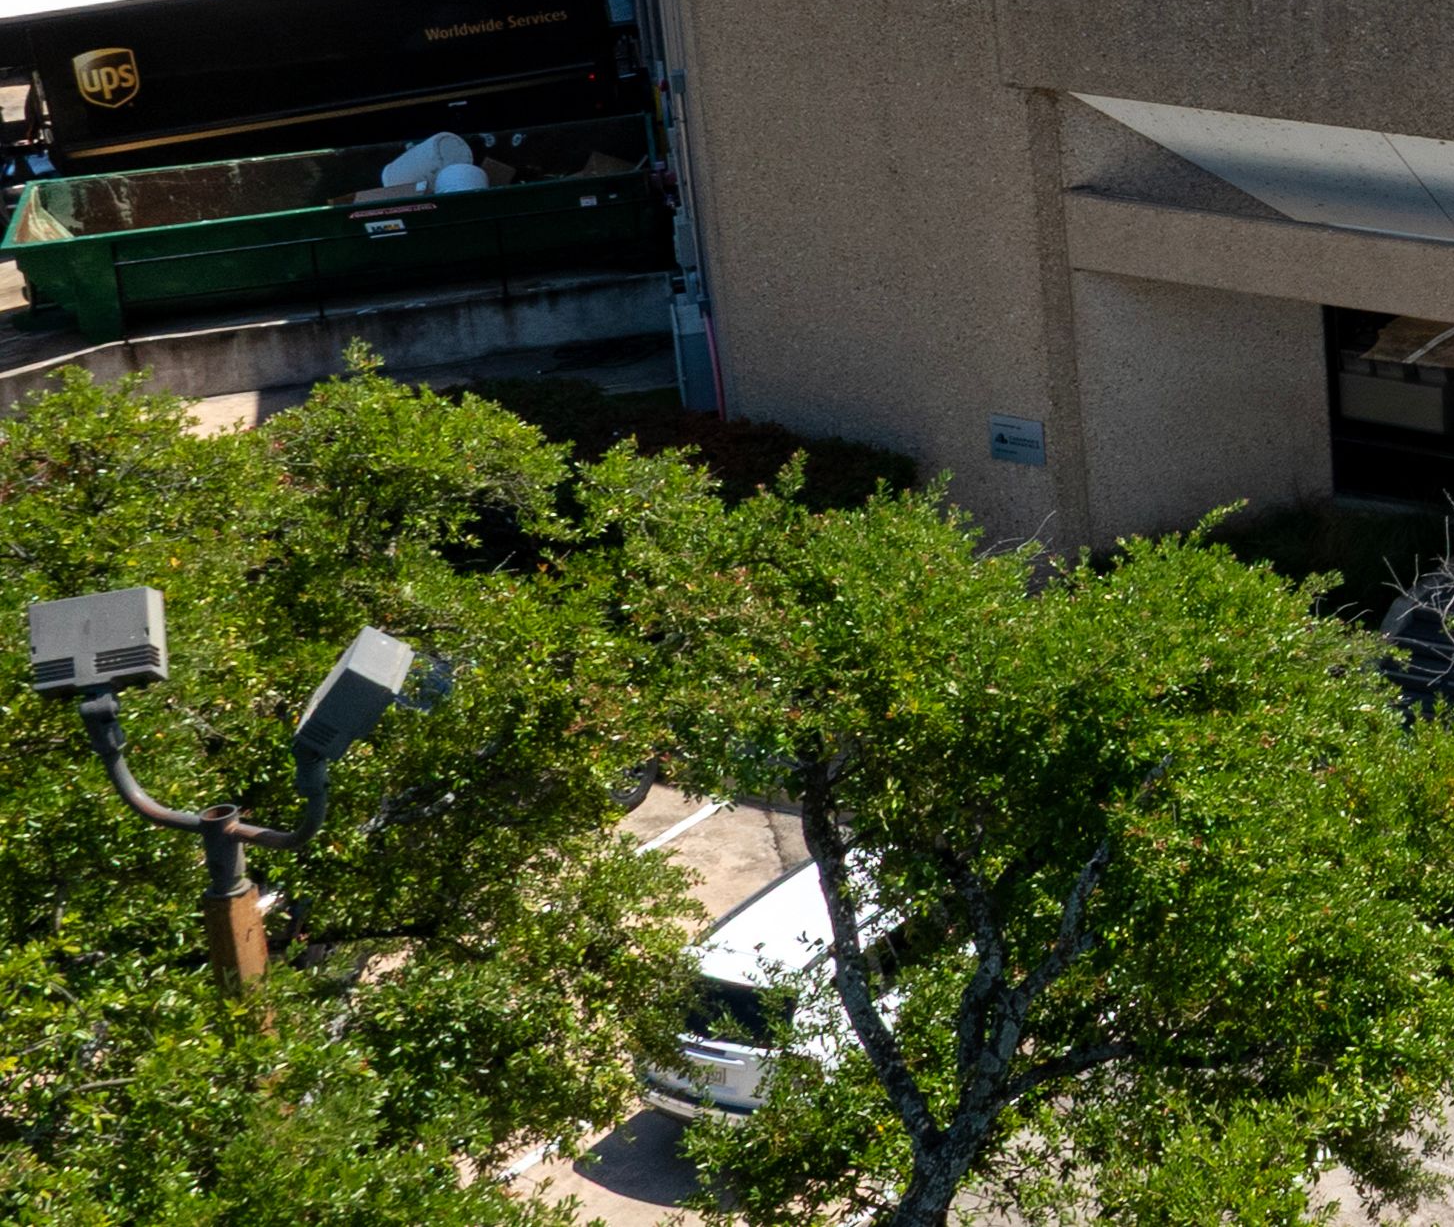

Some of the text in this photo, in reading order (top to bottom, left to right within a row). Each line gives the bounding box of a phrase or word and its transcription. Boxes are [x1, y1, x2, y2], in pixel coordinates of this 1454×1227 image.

[423, 9, 568, 42] Worldwide Services
[81, 63, 136, 100] ups
